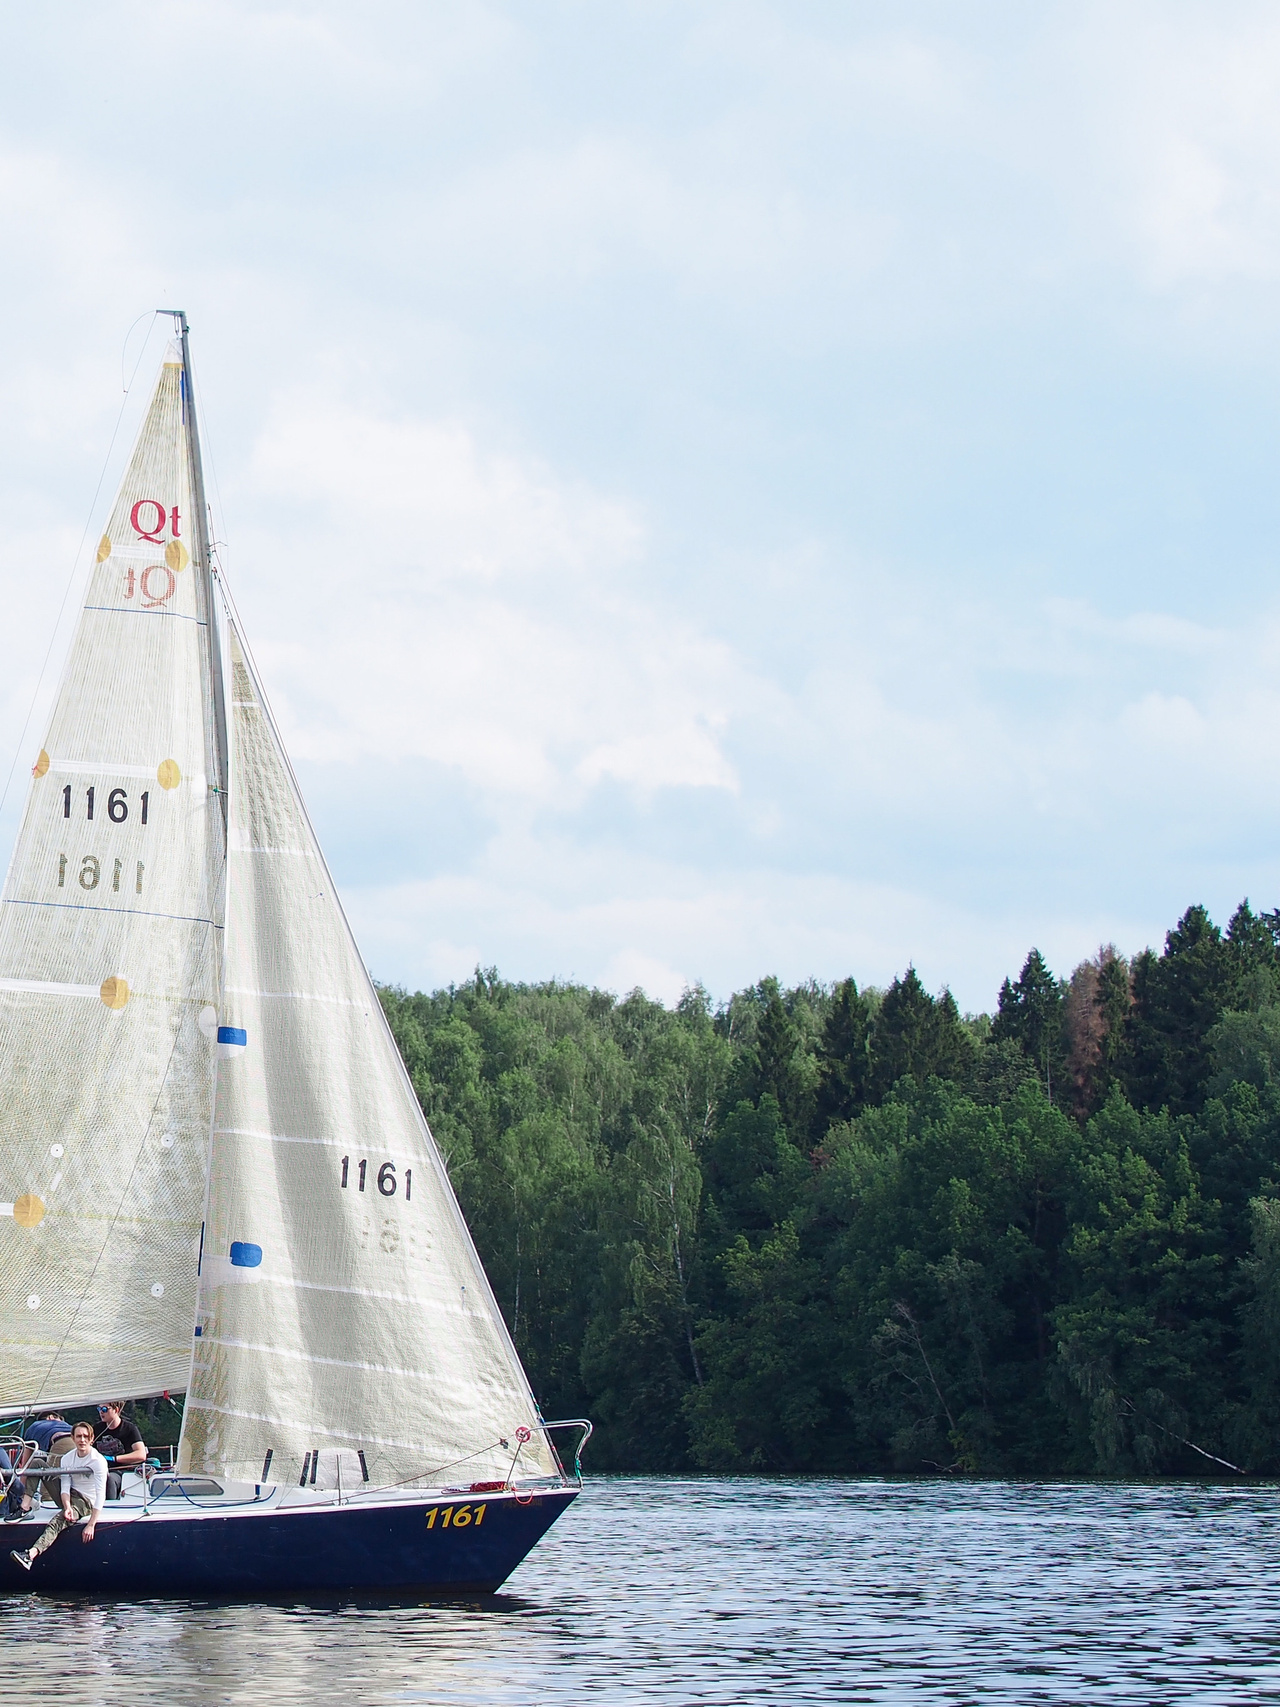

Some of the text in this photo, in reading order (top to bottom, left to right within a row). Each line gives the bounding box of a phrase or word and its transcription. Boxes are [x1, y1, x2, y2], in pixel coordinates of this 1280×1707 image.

[130, 499, 181, 545] Qt
[63, 785, 149, 825] 1161
[341, 1155, 412, 1201] 1161
[425, 1503, 487, 1529] 1161
